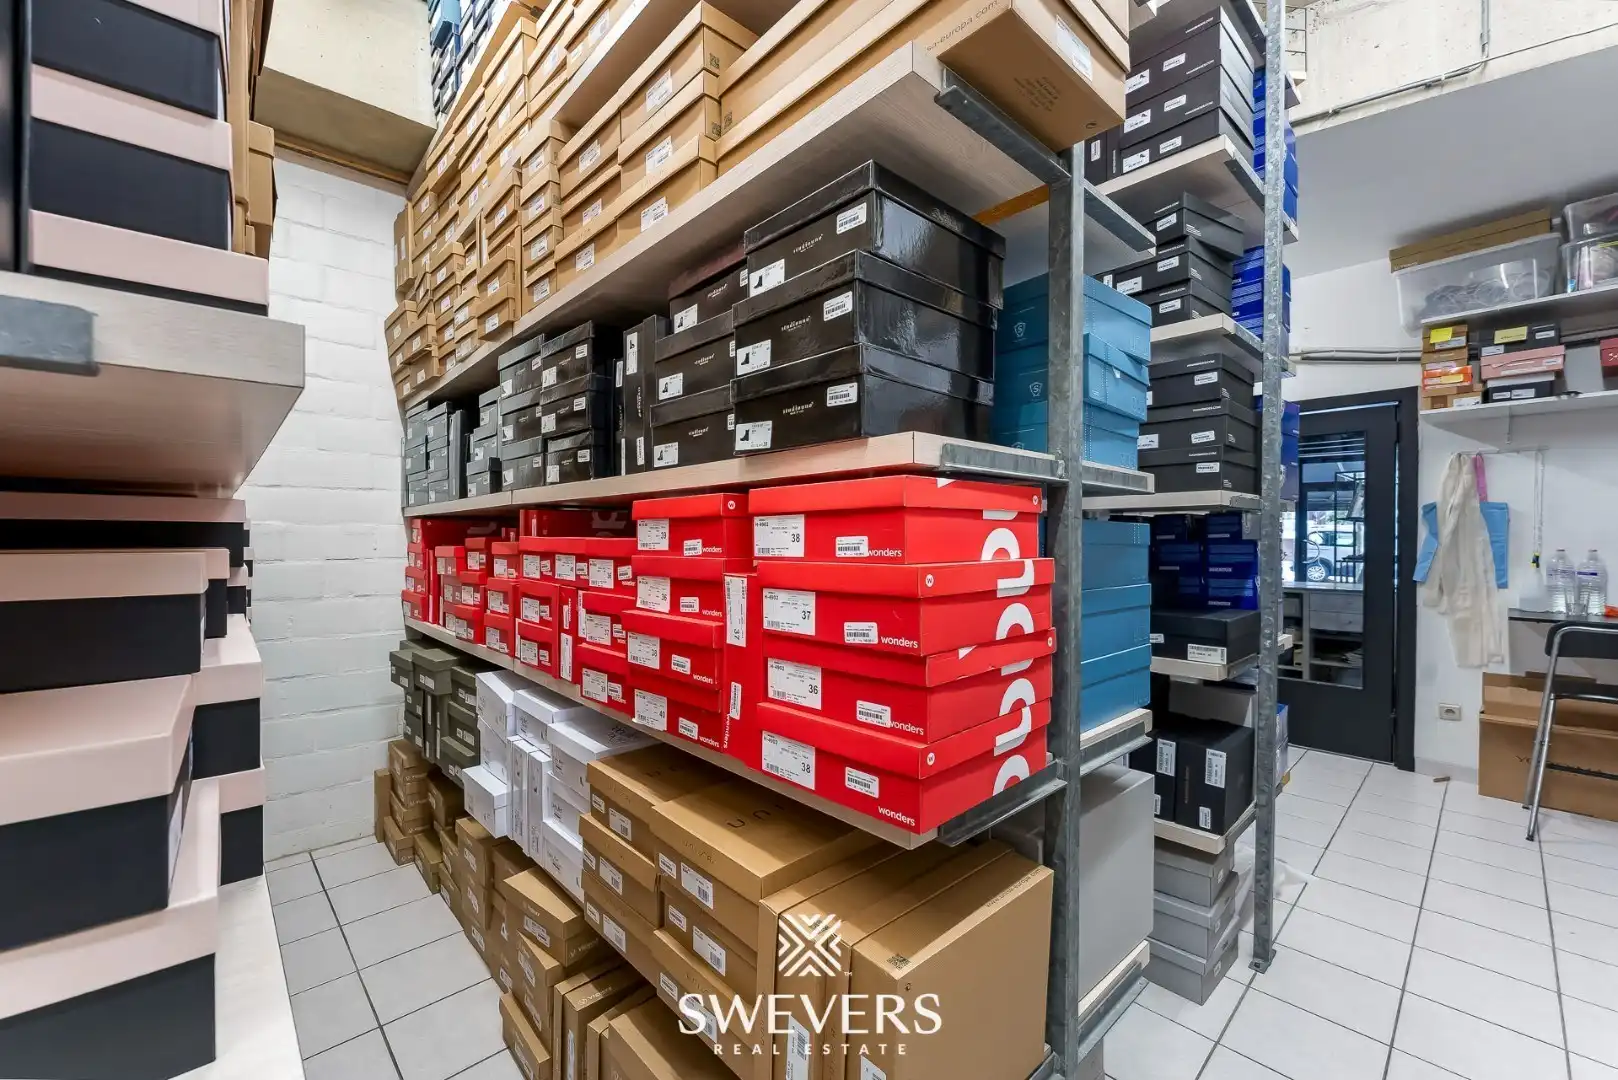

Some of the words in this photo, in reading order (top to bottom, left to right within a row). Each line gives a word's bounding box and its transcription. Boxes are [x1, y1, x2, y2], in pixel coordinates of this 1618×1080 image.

[791, 533, 801, 543] 38
[701, 609, 722, 618] wonders
[801, 610, 812, 620] 37
[733, 628, 741, 641] 37
[880, 635, 919, 649] wonders
[692, 673, 713, 685] wonders
[808, 684, 819, 695] 36
[699, 735, 720, 748] wonders
[801, 762, 811, 774] 38
[877, 805, 916, 827] wonders
